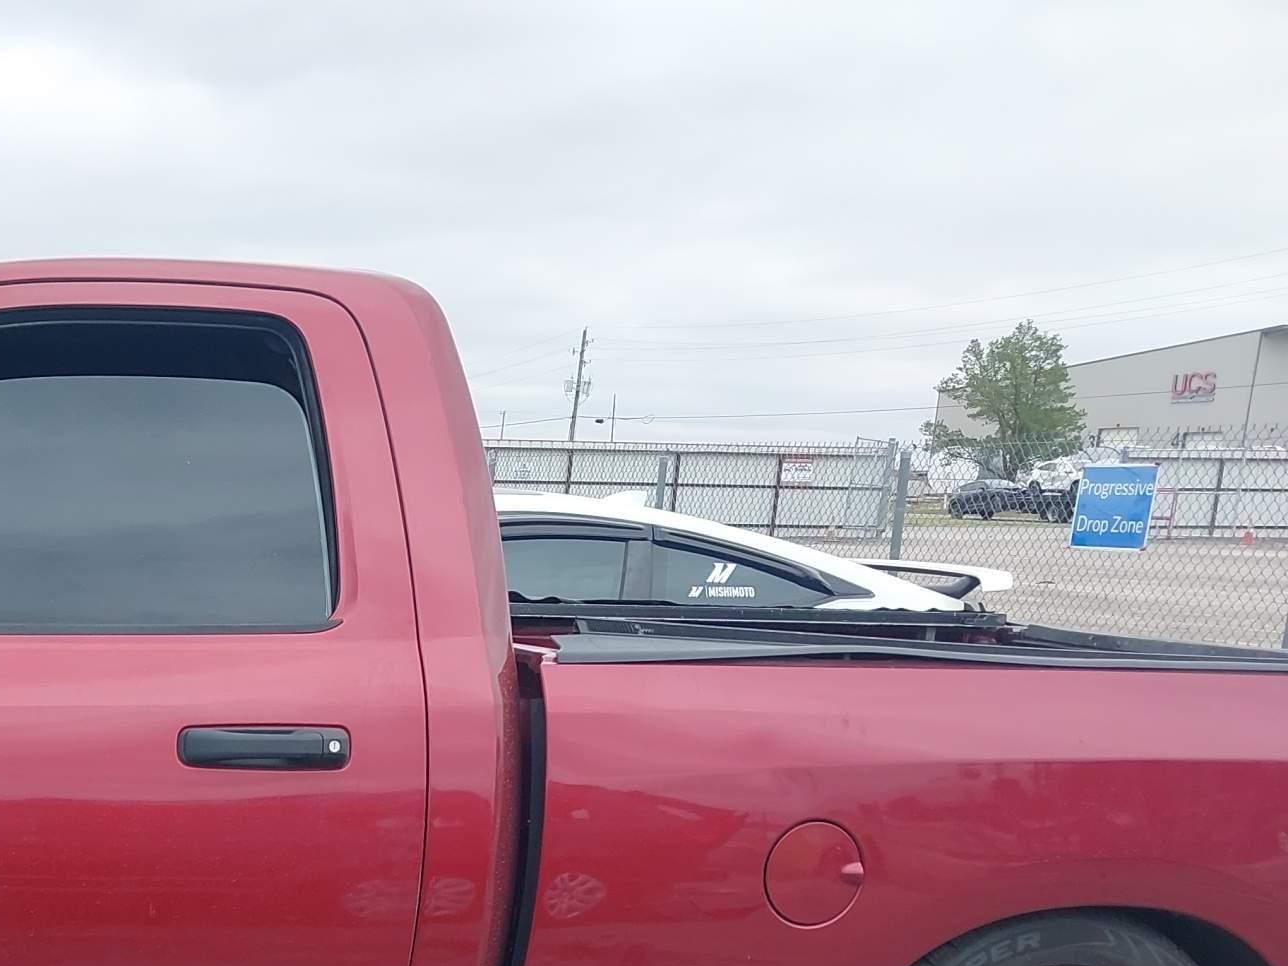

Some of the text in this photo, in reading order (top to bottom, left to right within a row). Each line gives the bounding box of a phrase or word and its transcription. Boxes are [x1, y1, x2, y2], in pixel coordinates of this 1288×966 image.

[1172, 372, 1217, 396] UCS
[1080, 479, 1154, 499] Progressive
[1076, 515, 1144, 536] Drop Zone
[708, 586, 756, 598] MISHIMOTO
